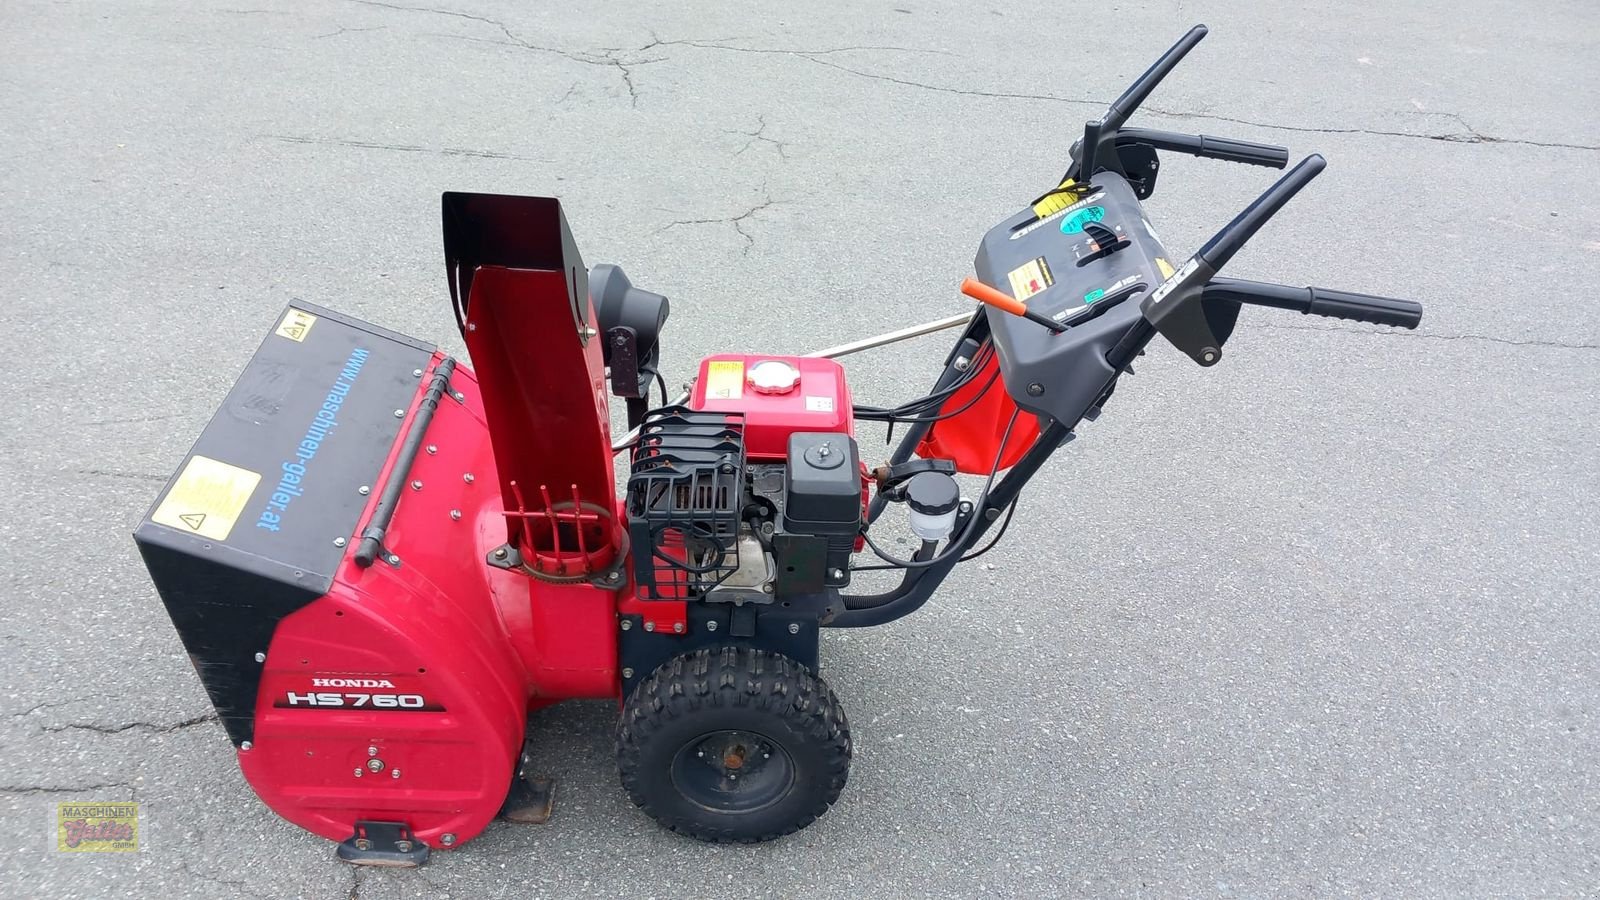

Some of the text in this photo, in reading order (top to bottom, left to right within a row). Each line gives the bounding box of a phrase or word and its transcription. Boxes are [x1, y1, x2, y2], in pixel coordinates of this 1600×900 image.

[256, 348, 370, 532] www.maschinen-gailer.at
[312, 678, 395, 688] HONDA
[286, 691, 425, 708] HS760
